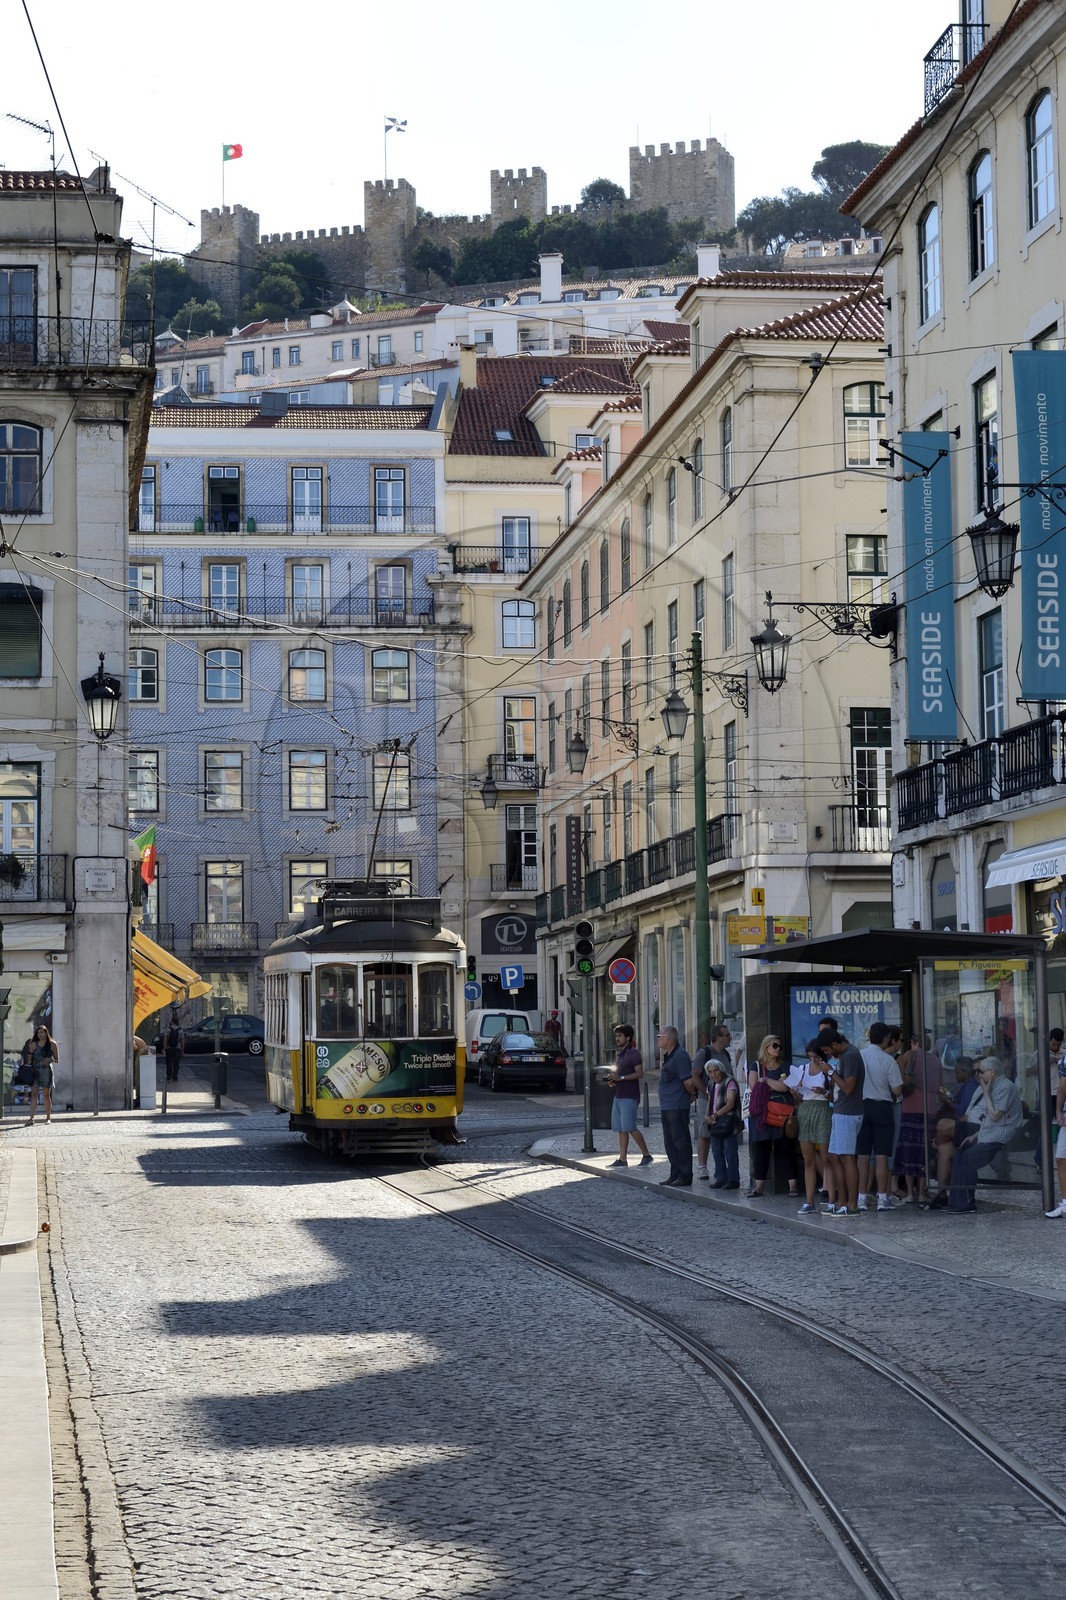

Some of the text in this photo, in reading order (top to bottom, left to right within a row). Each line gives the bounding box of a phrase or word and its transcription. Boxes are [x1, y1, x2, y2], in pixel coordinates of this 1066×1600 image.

[1036, 393, 1049, 465] movimento
[1041, 494, 1051, 530] moda
[921, 472, 934, 592] moda em moviment
[1037, 553, 1060, 668] SEASIDE
[920, 612, 943, 713] SEASIDE
[1030, 859, 1059, 878] SEASIDE
[757, 891, 763, 903] L
[334, 907, 379, 917] CARREIRA
[958, 961, 969, 970] Pç.
[505, 967, 519, 987] P
[795, 989, 893, 1004] UMA CORRIDA
[810, 1002, 879, 1015] DE ALTOS VÔOS
[354, 1044, 387, 1079] JAMESON
[403, 1062, 424, 1070] Twice
[411, 1052, 456, 1063] Triple Distilled
